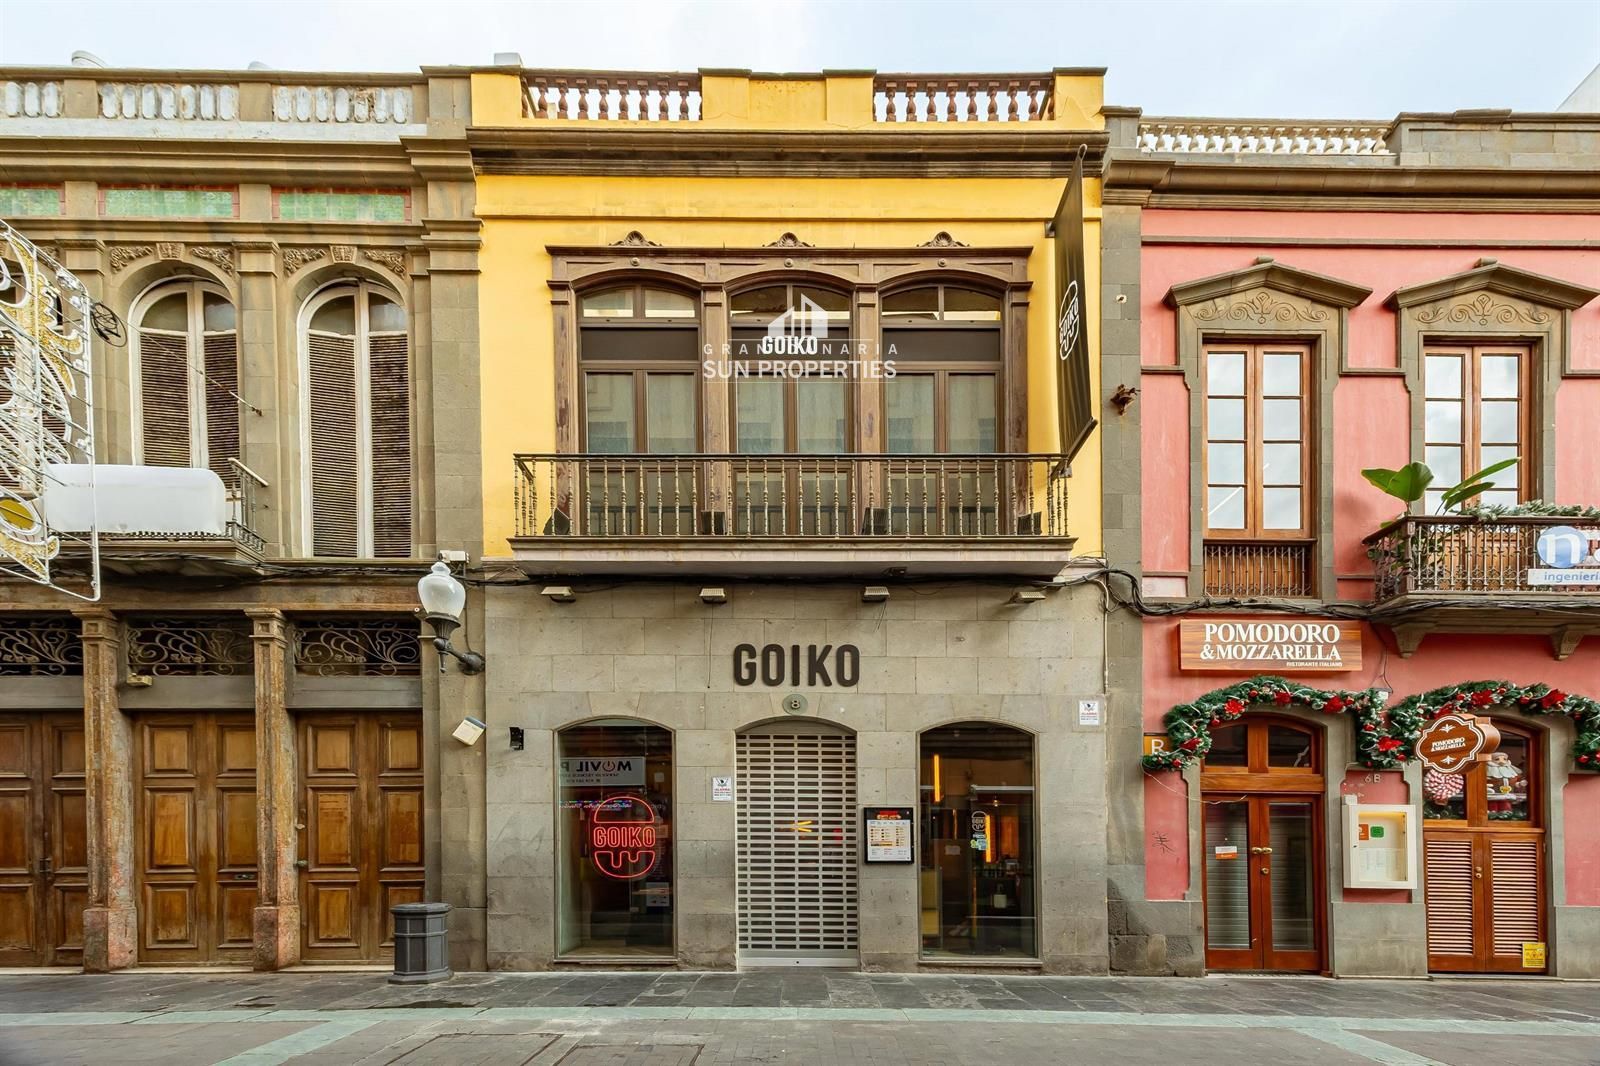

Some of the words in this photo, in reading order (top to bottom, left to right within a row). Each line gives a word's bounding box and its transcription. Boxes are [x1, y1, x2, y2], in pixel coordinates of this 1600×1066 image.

[762, 335, 818, 355] GOIKO
[1204, 623, 1341, 643] POMODORO
[734, 643, 860, 687] GOIKO
[791, 699, 800, 709] 8
[593, 826, 656, 848] GOIKO
